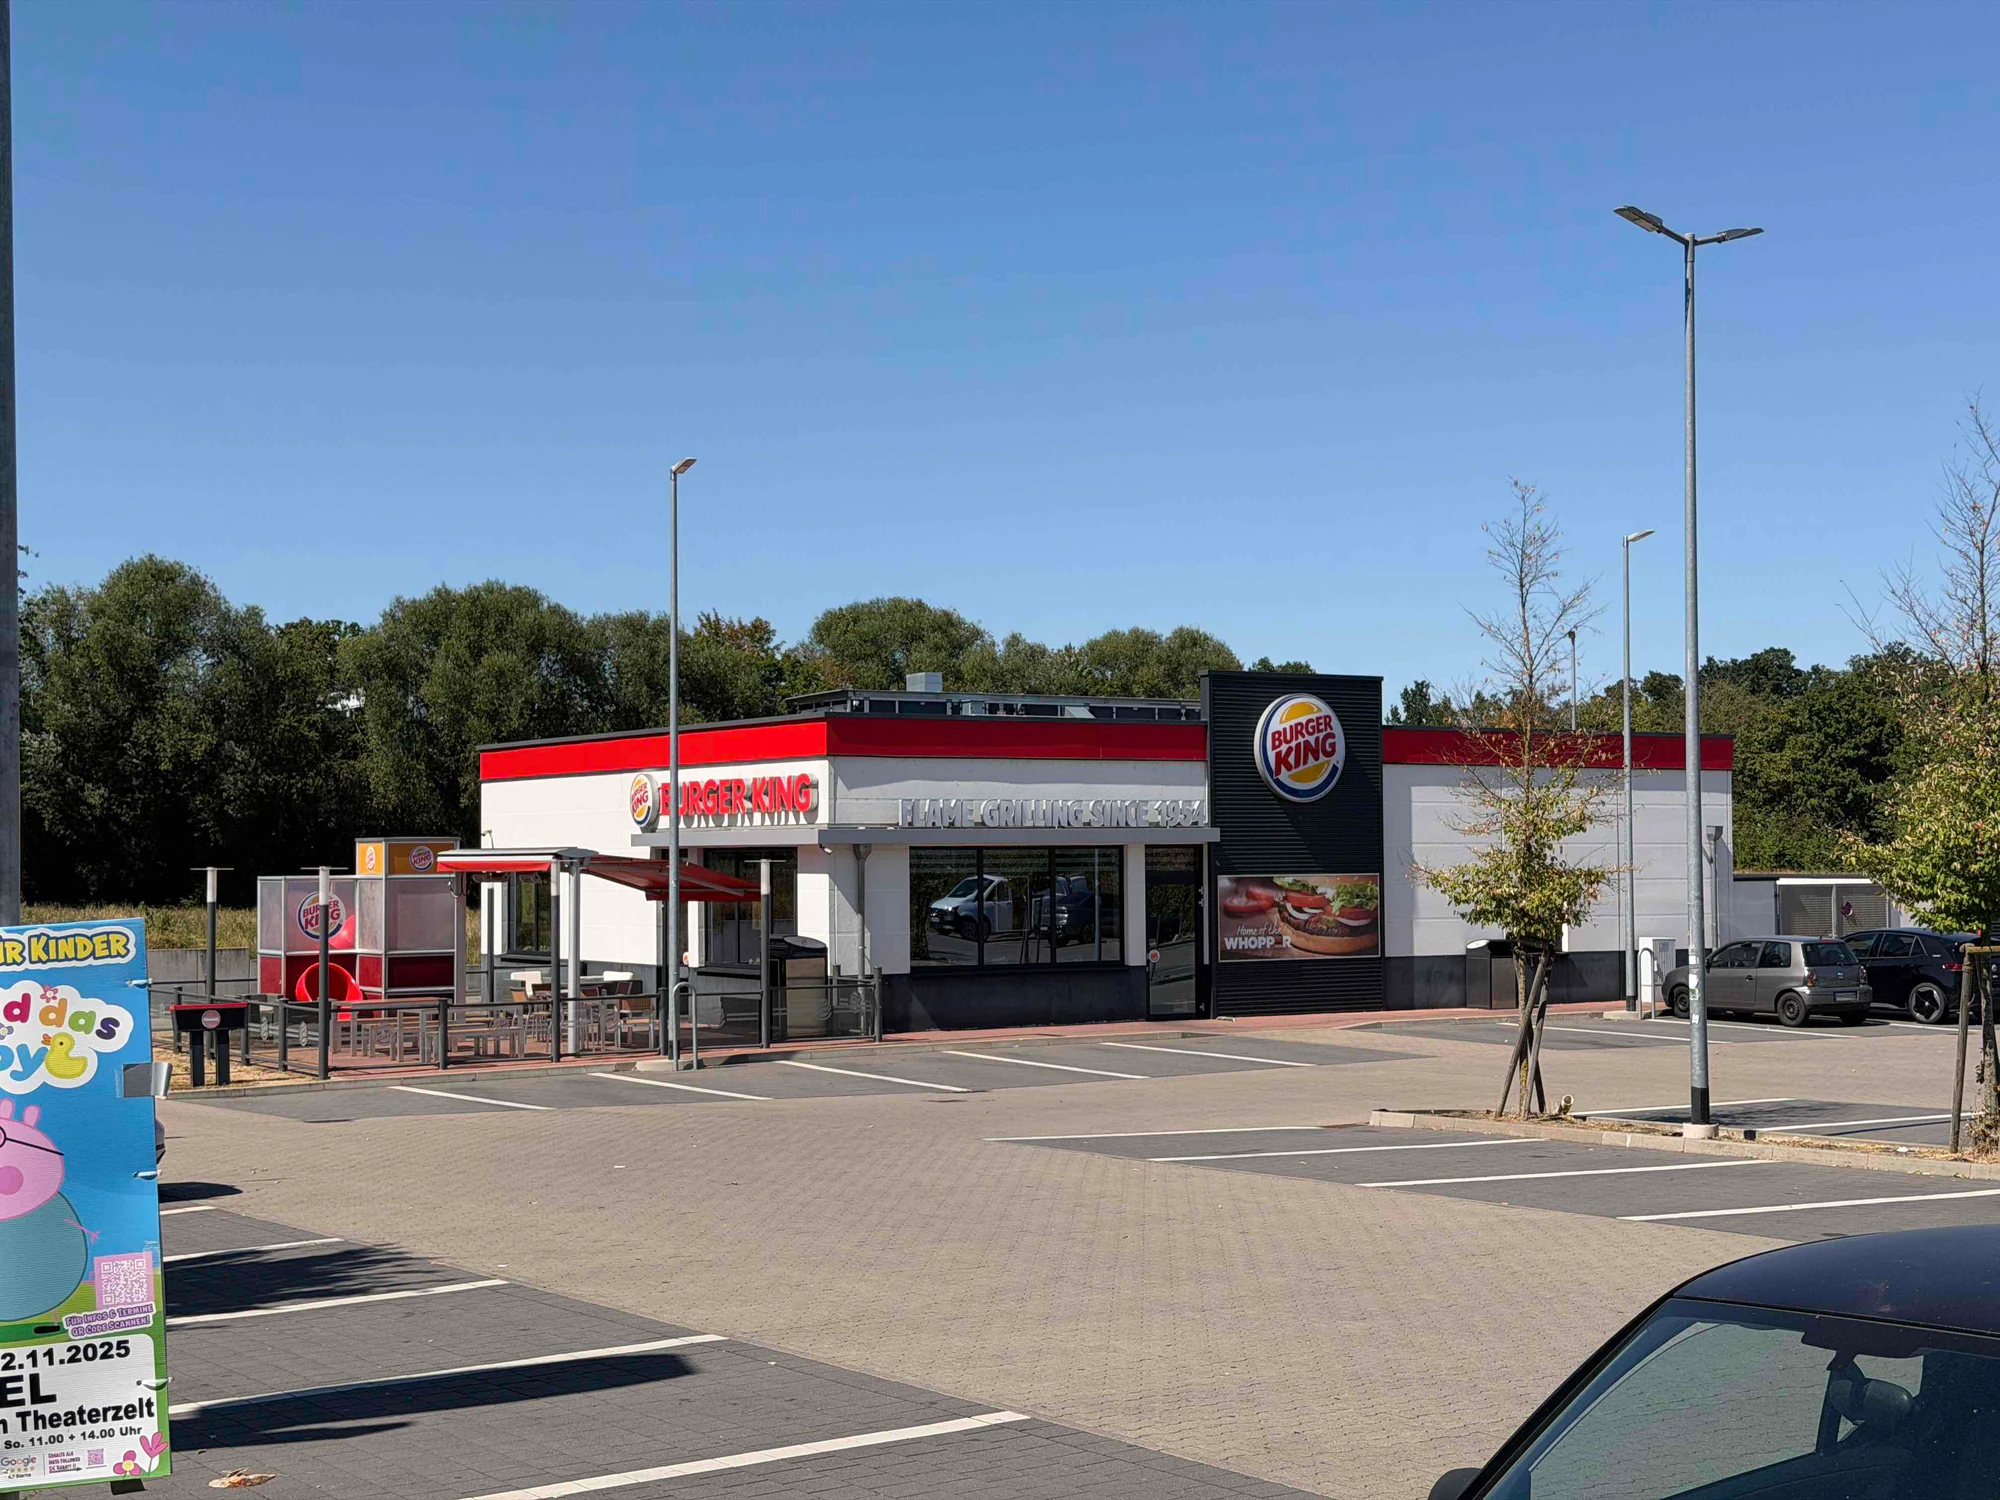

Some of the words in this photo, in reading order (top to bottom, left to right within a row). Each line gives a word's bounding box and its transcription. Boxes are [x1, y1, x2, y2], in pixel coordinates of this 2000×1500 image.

[1271, 715, 1334, 751] BURGER
[1274, 732, 1336, 777] KING
[751, 773, 812, 813] KING
[899, 799, 975, 827] FLAME
[981, 799, 1084, 827] GRILLING
[1089, 799, 1150, 827] SINCE
[1156, 799, 1206, 827] 1954
[303, 900, 339, 919] BURER
[304, 908, 341, 930] KIG
[1237, 924, 1259, 936] Home
[1259, 922, 1269, 936] of
[1269, 922, 1282, 935] the
[28, 931, 130, 964] KINDER
[71, 1325, 86, 1337] QR
[85, 1322, 109, 1334] CODE
[108, 1314, 151, 1330] SCANNEN!
[83, 1311, 109, 1324] INFOS
[109, 1308, 117, 1319] &
[117, 1303, 154, 1318] TERMINE
[0, 1339, 131, 1371] 2.11.2025
[15, 1397, 155, 1432] Theaterzelt
[4, 1440, 24, 1450] So.
[29, 1433, 64, 1446] 11.00
[68, 1434, 76, 1442] +
[80, 1428, 115, 1441] 14.00
[119, 1426, 143, 1436] Uhr
[1, 1455, 37, 1467] Google
